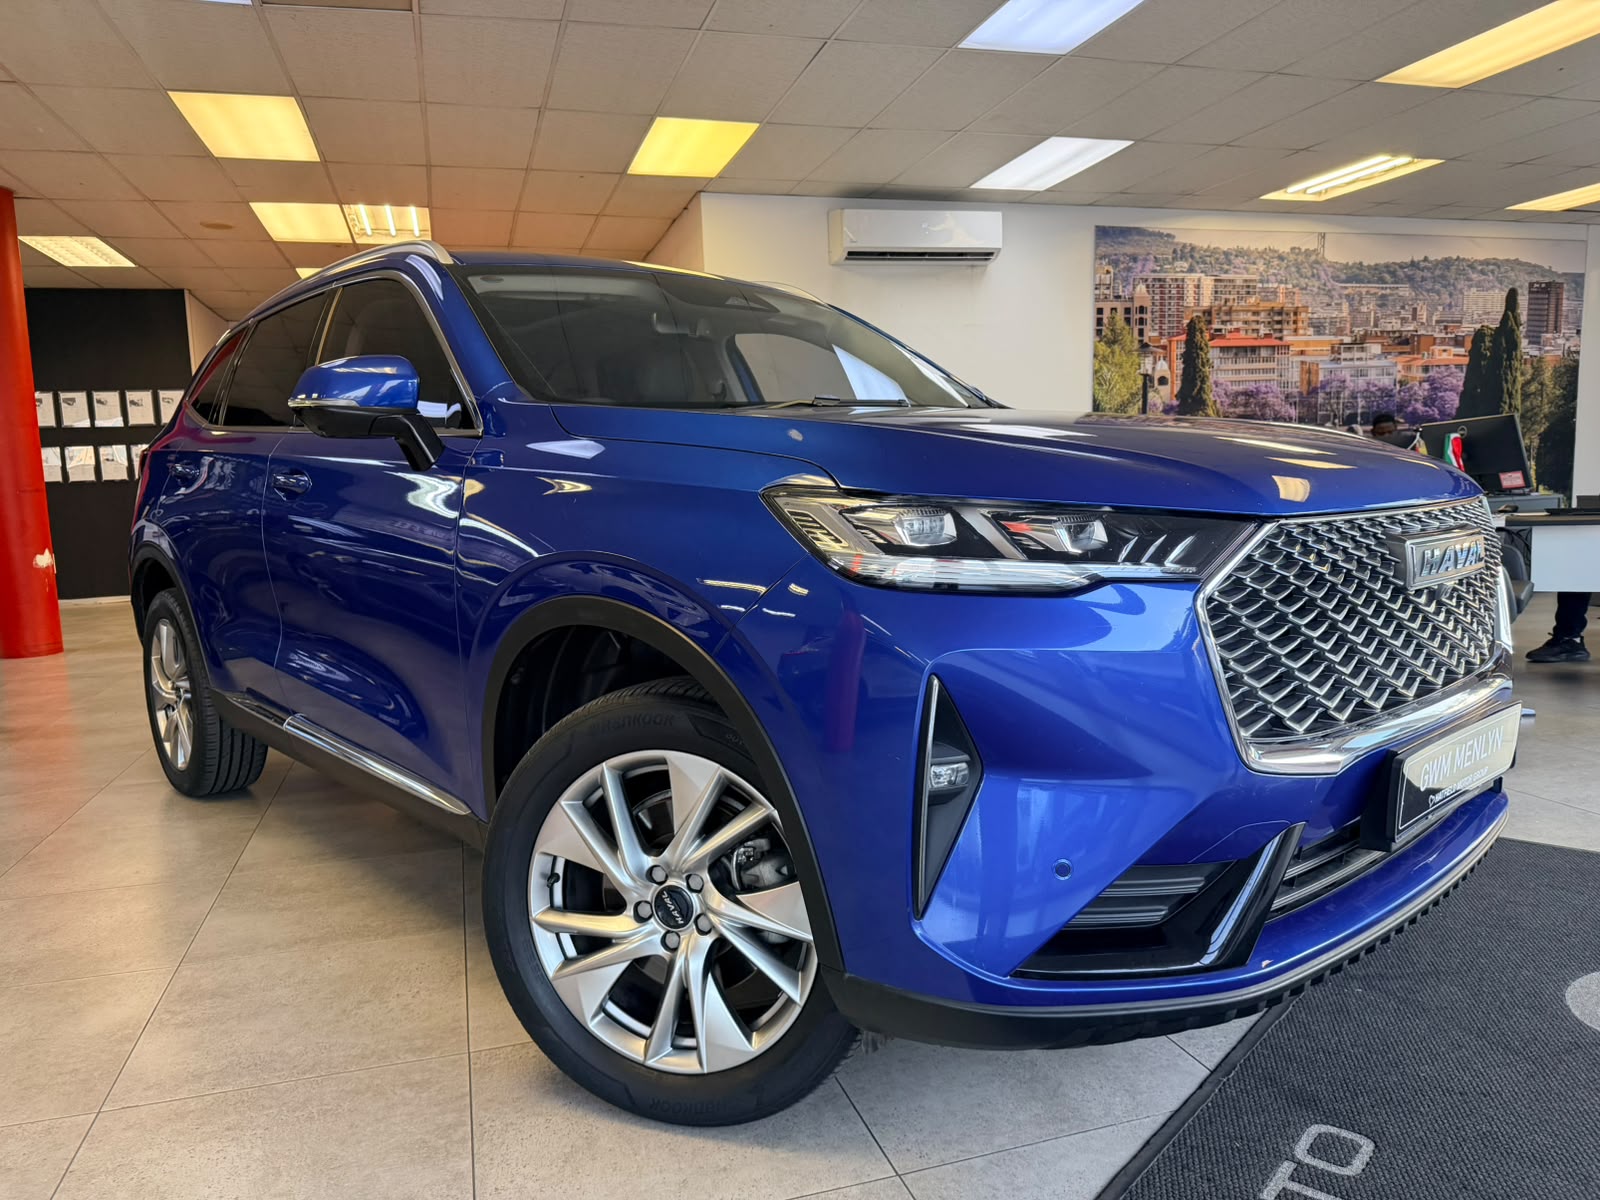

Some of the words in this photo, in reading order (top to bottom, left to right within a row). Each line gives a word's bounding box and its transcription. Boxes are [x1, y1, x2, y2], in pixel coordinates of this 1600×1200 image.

[1420, 540, 1484, 577] HAVAL
[1419, 750, 1453, 792] GWM
[1453, 725, 1505, 773] MENLYN
[661, 890, 685, 924] HAVAL
